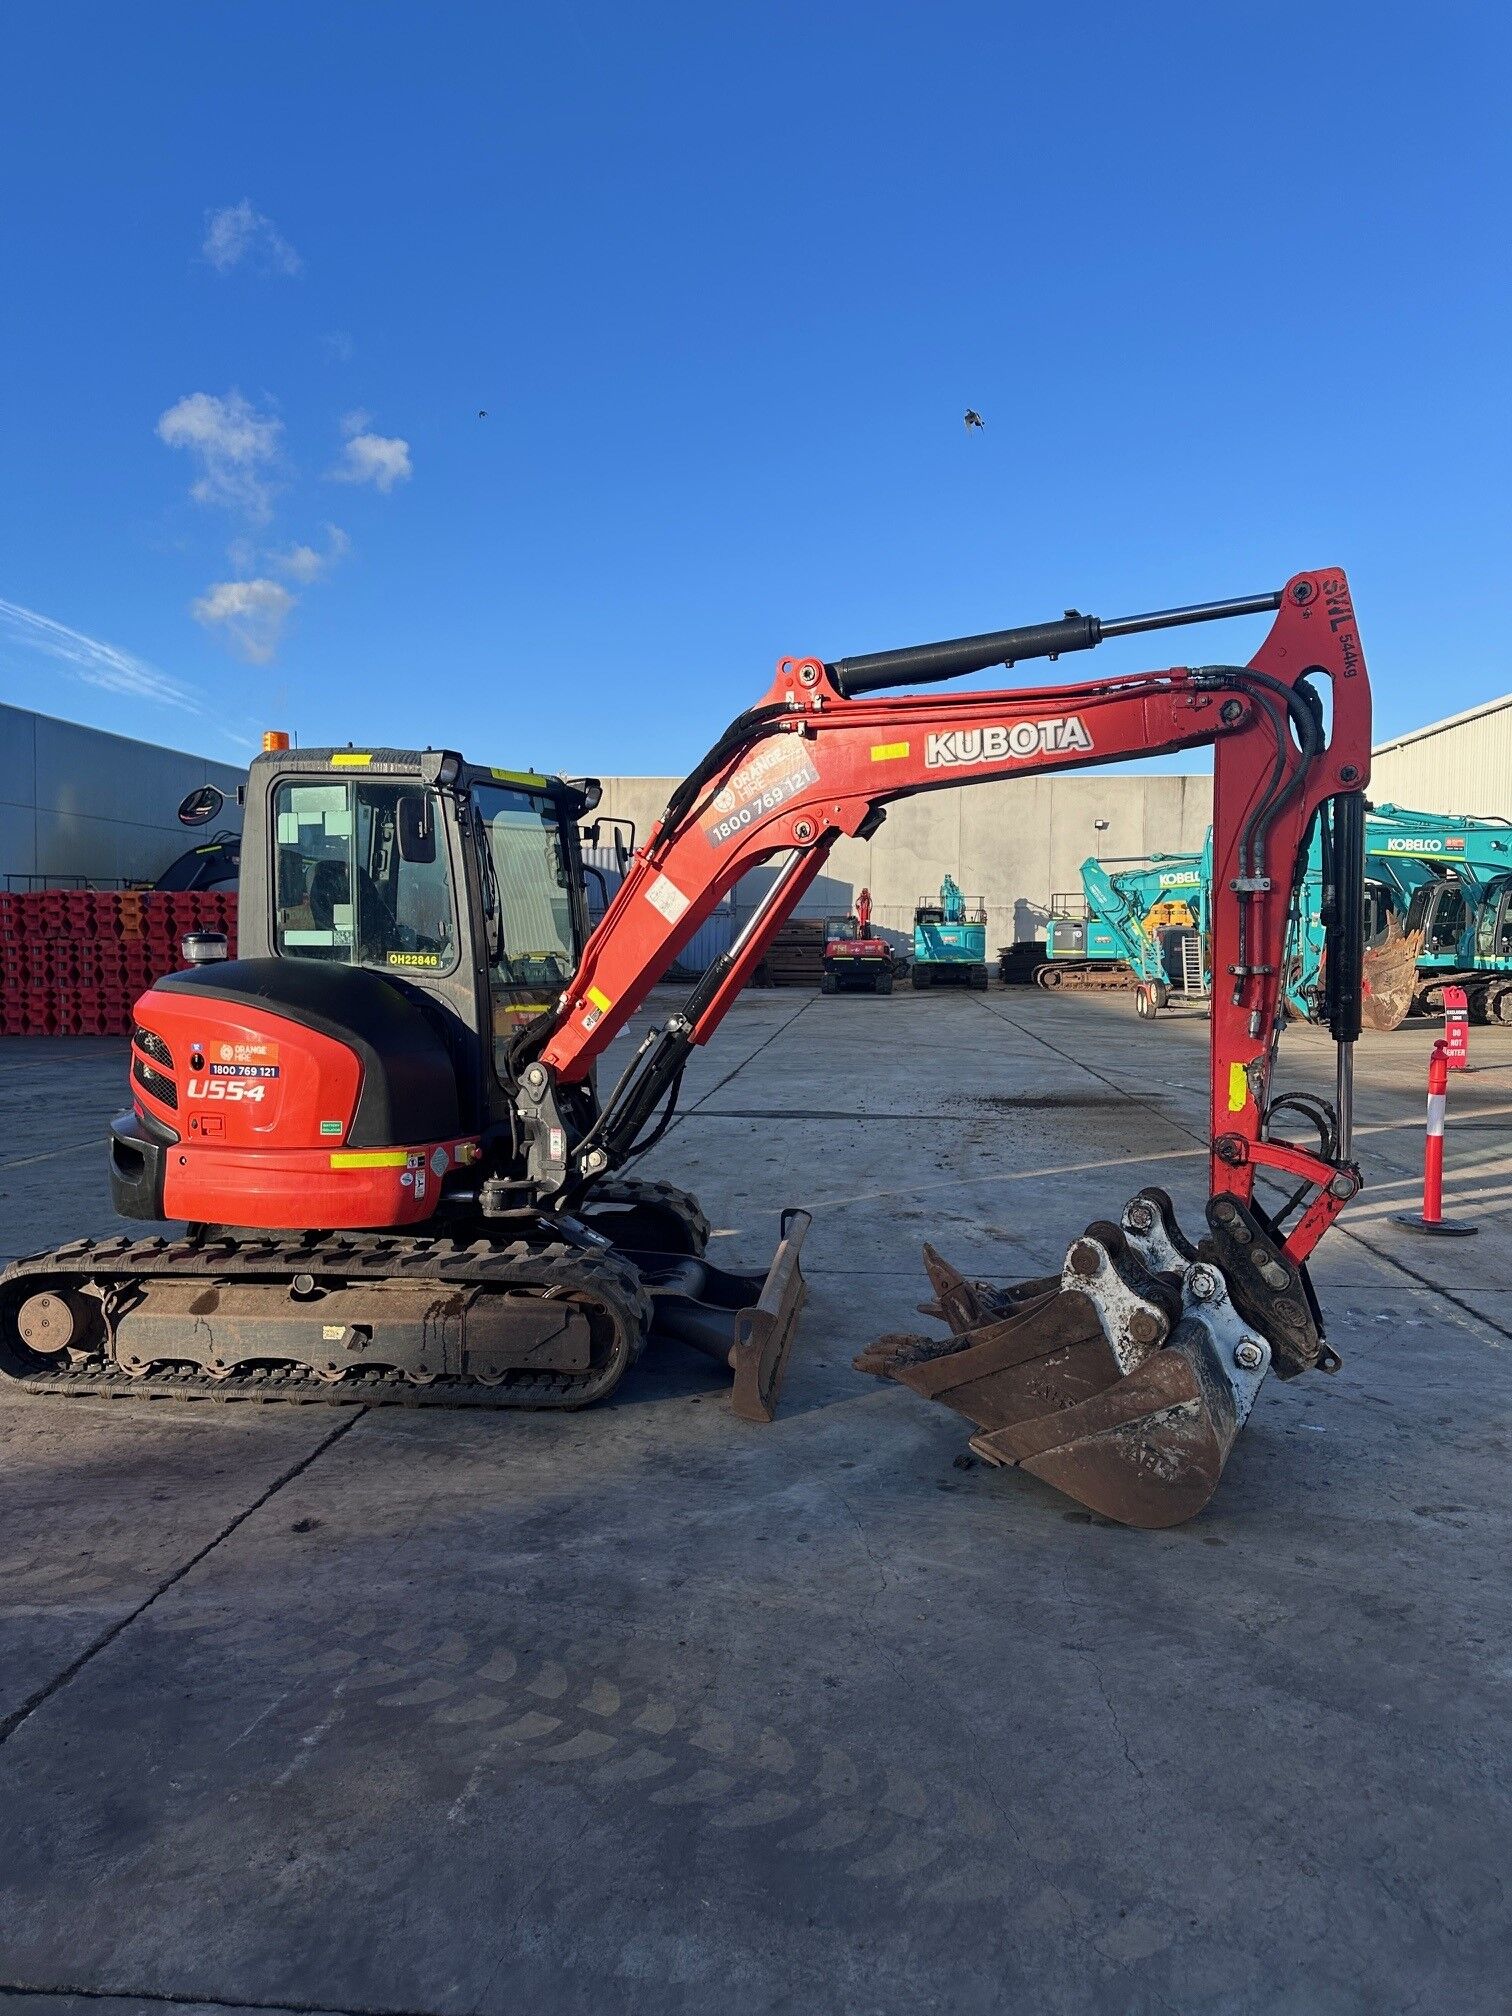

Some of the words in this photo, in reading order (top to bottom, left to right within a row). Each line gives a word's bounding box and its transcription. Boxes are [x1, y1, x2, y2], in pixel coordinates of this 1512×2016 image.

[1322, 579, 1354, 633] SWL
[926, 715, 1093, 766] KUBOTA
[738, 777, 766, 801] HIRE
[712, 809, 751, 841] 1800
[752, 786, 784, 815] 769
[784, 768, 811, 792] 121
[1387, 838, 1442, 852] KOBELCO
[390, 954, 438, 966] OH22846
[1452, 1029, 1461, 1037] DO
[234, 1044, 268, 1055] ORANGE
[234, 1053, 253, 1063] HIRE
[212, 1065, 236, 1076] 1800
[238, 1066, 258, 1076] 769
[259, 1067, 276, 1077] 121
[187, 1078, 266, 1102] U55-4
